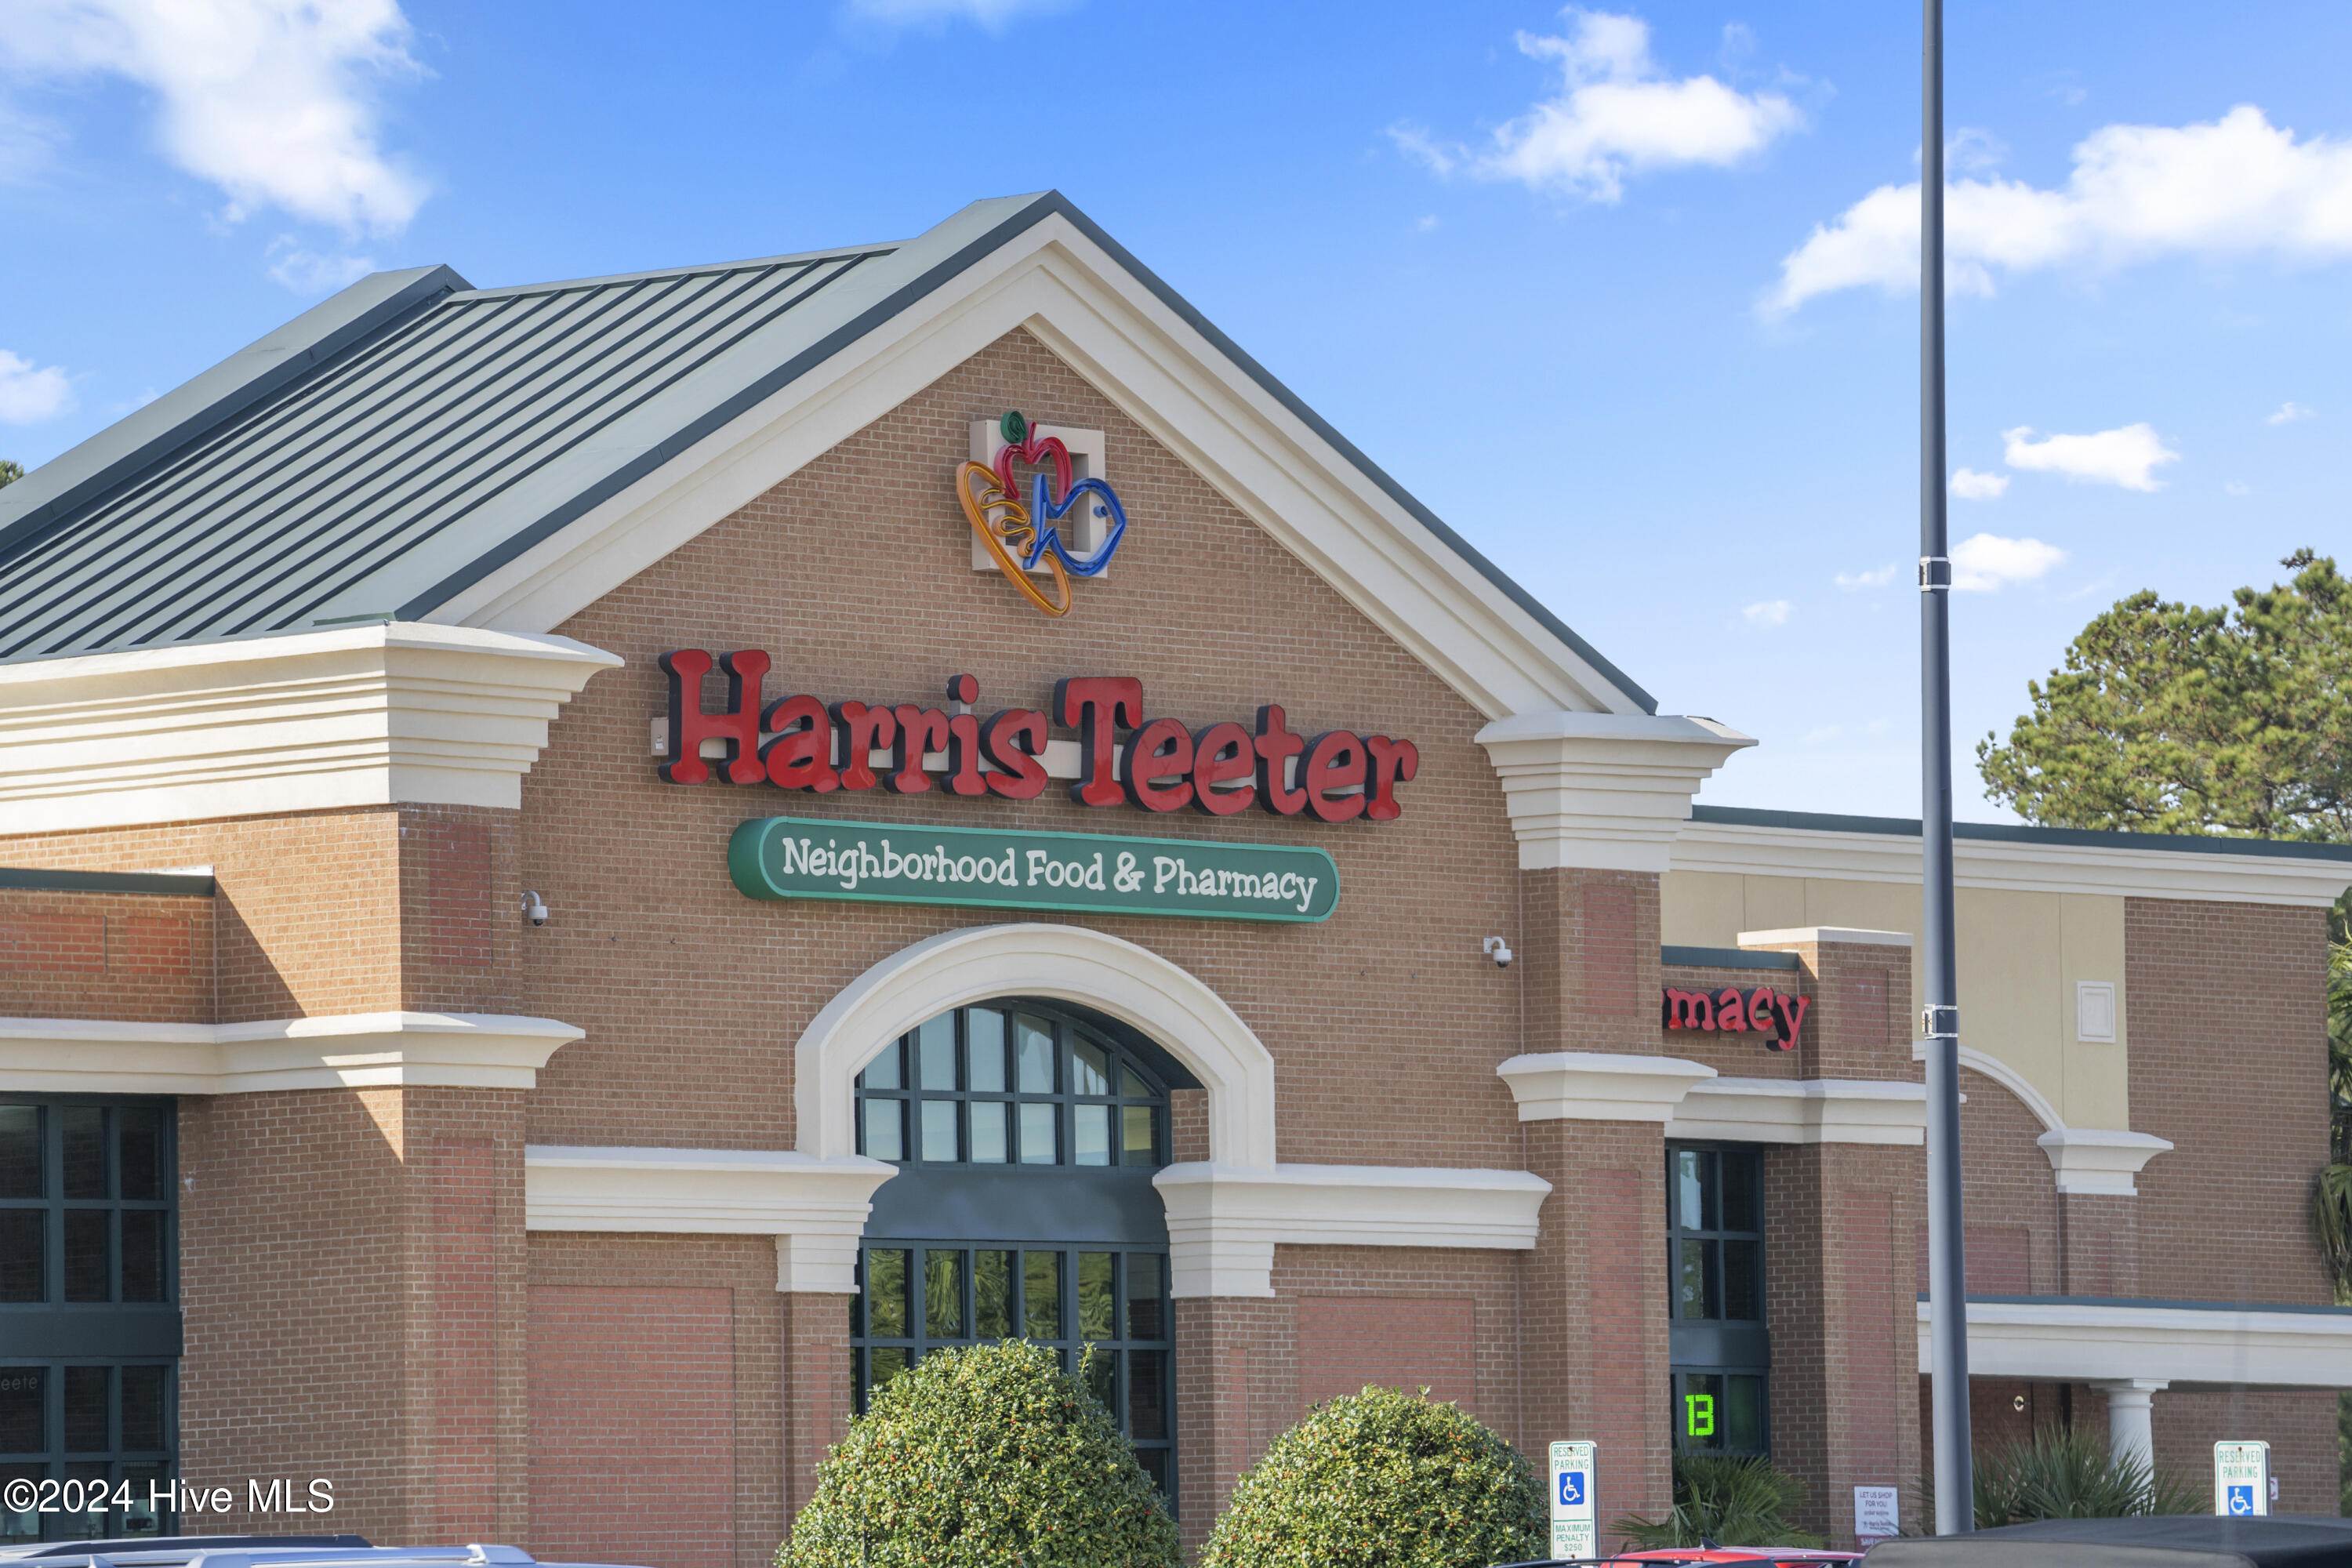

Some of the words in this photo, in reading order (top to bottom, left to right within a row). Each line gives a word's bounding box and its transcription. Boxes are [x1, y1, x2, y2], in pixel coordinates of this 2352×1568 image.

[659, 648, 1049, 800] Harris
[1054, 677, 1418, 823] Teeter
[782, 837, 1019, 890] Neighborhood
[1027, 849, 1104, 891] Food
[1112, 852, 1145, 893] &
[1153, 858, 1318, 913] Pharmacy
[1662, 987, 1811, 1051] macy
[1554, 1446, 1589, 1457] RESERVED
[2219, 1450, 2261, 1463] RESERVED
[1555, 1459, 1589, 1470] PARKING
[2223, 1466, 2258, 1479] PARKING
